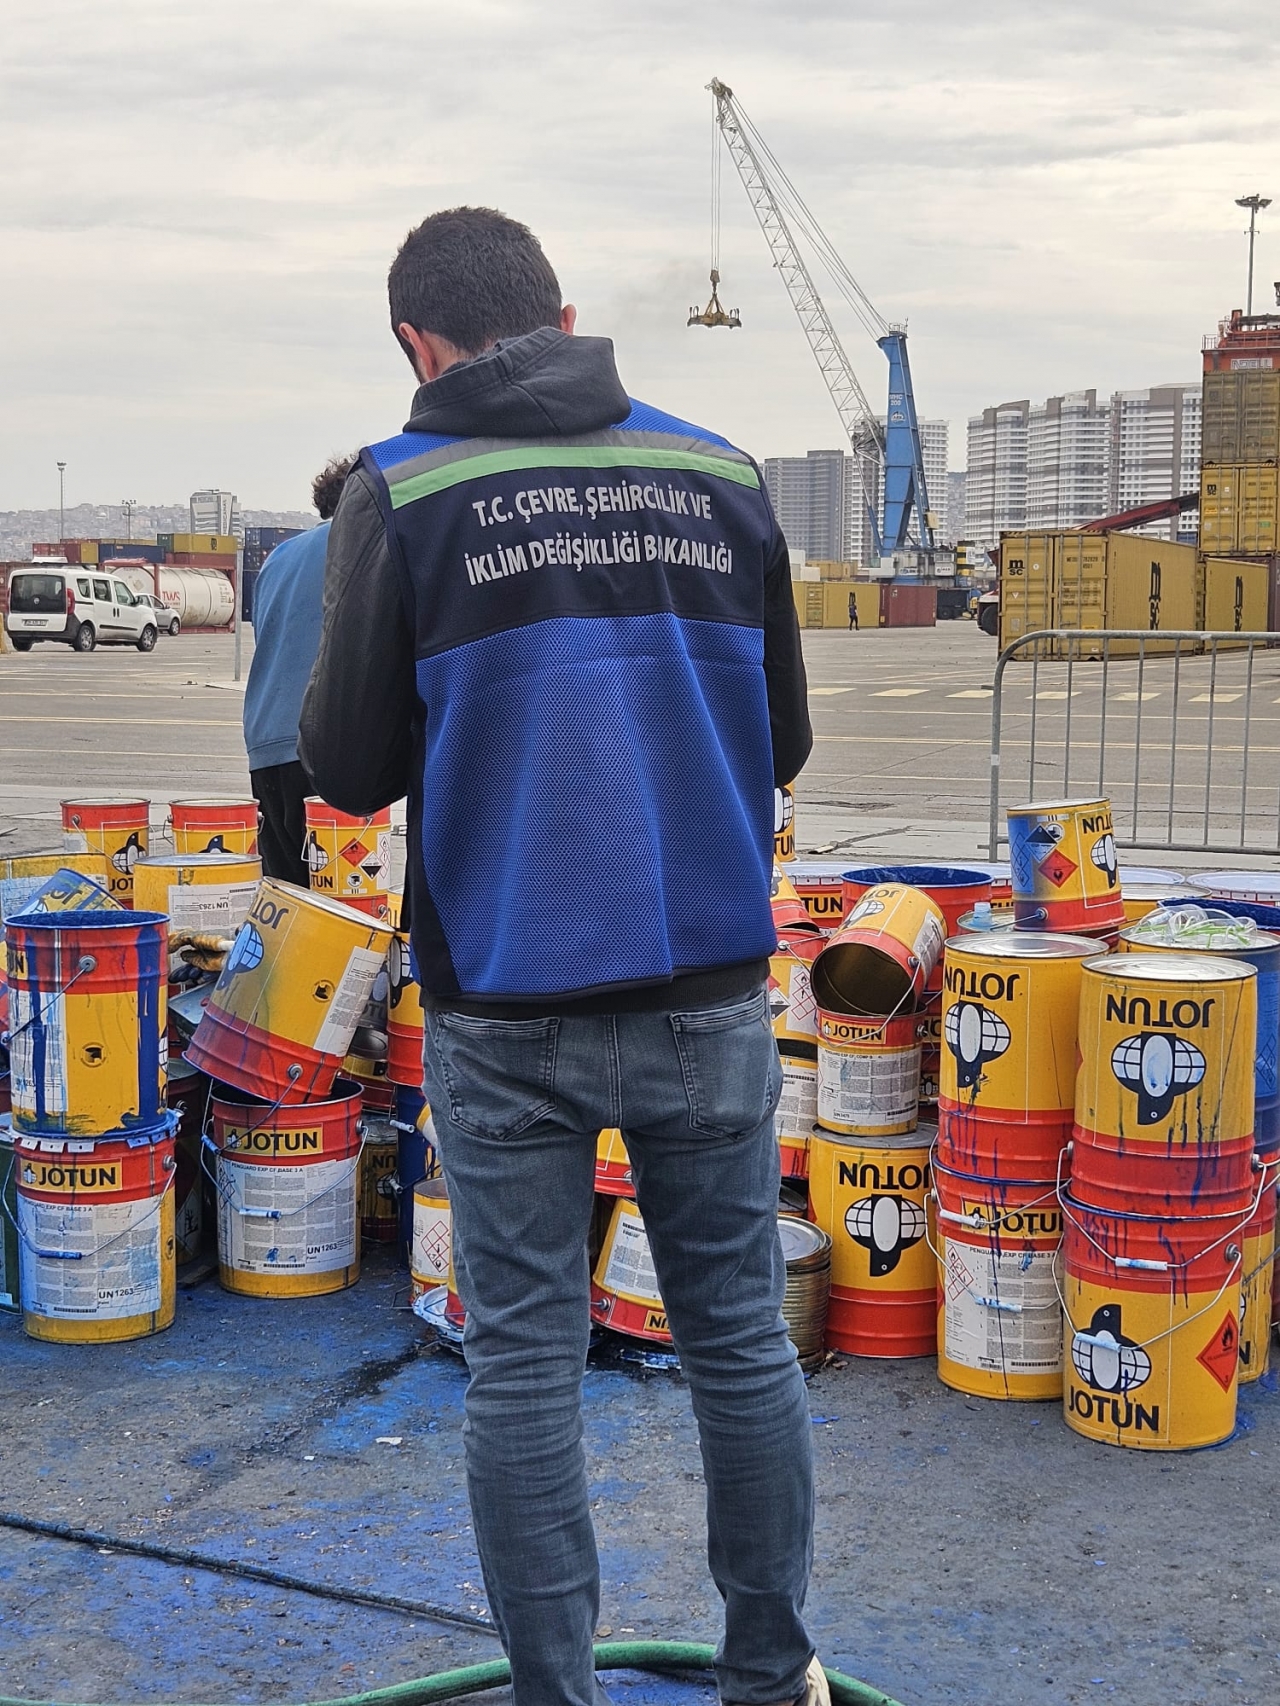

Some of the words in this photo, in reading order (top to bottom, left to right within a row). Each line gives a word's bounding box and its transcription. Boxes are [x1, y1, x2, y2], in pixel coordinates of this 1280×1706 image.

[472, 496, 514, 527] T.C.
[515, 487, 584, 523] ÇEVRE,
[586, 480, 690, 520] ŞEHİRCİLİK
[691, 492, 713, 520] VE
[464, 544, 529, 586] İKLİM
[528, 530, 641, 572] DEĞİŞİKLİĞİ
[644, 534, 733, 574] BAKANLIĞI
[1082, 813, 1113, 834] TUN
[944, 964, 1021, 1001] JOTUN
[1105, 993, 1216, 1028] JOTUN
[832, 1024, 882, 1041] JOTUN
[243, 1131, 318, 1151] JOTUN
[39, 1166, 116, 1188] JOTUN
[839, 1160, 932, 1190] JOTUN
[989, 1211, 1063, 1234] JOTU
[307, 1246, 321, 1255] UN
[321, 1243, 338, 1252] 1263
[969, 1246, 1002, 1257] PENGUA
[98, 1290, 114, 1299] UN
[115, 1287, 134, 1297] 1263
[1069, 1385, 1160, 1431] JOTUN
